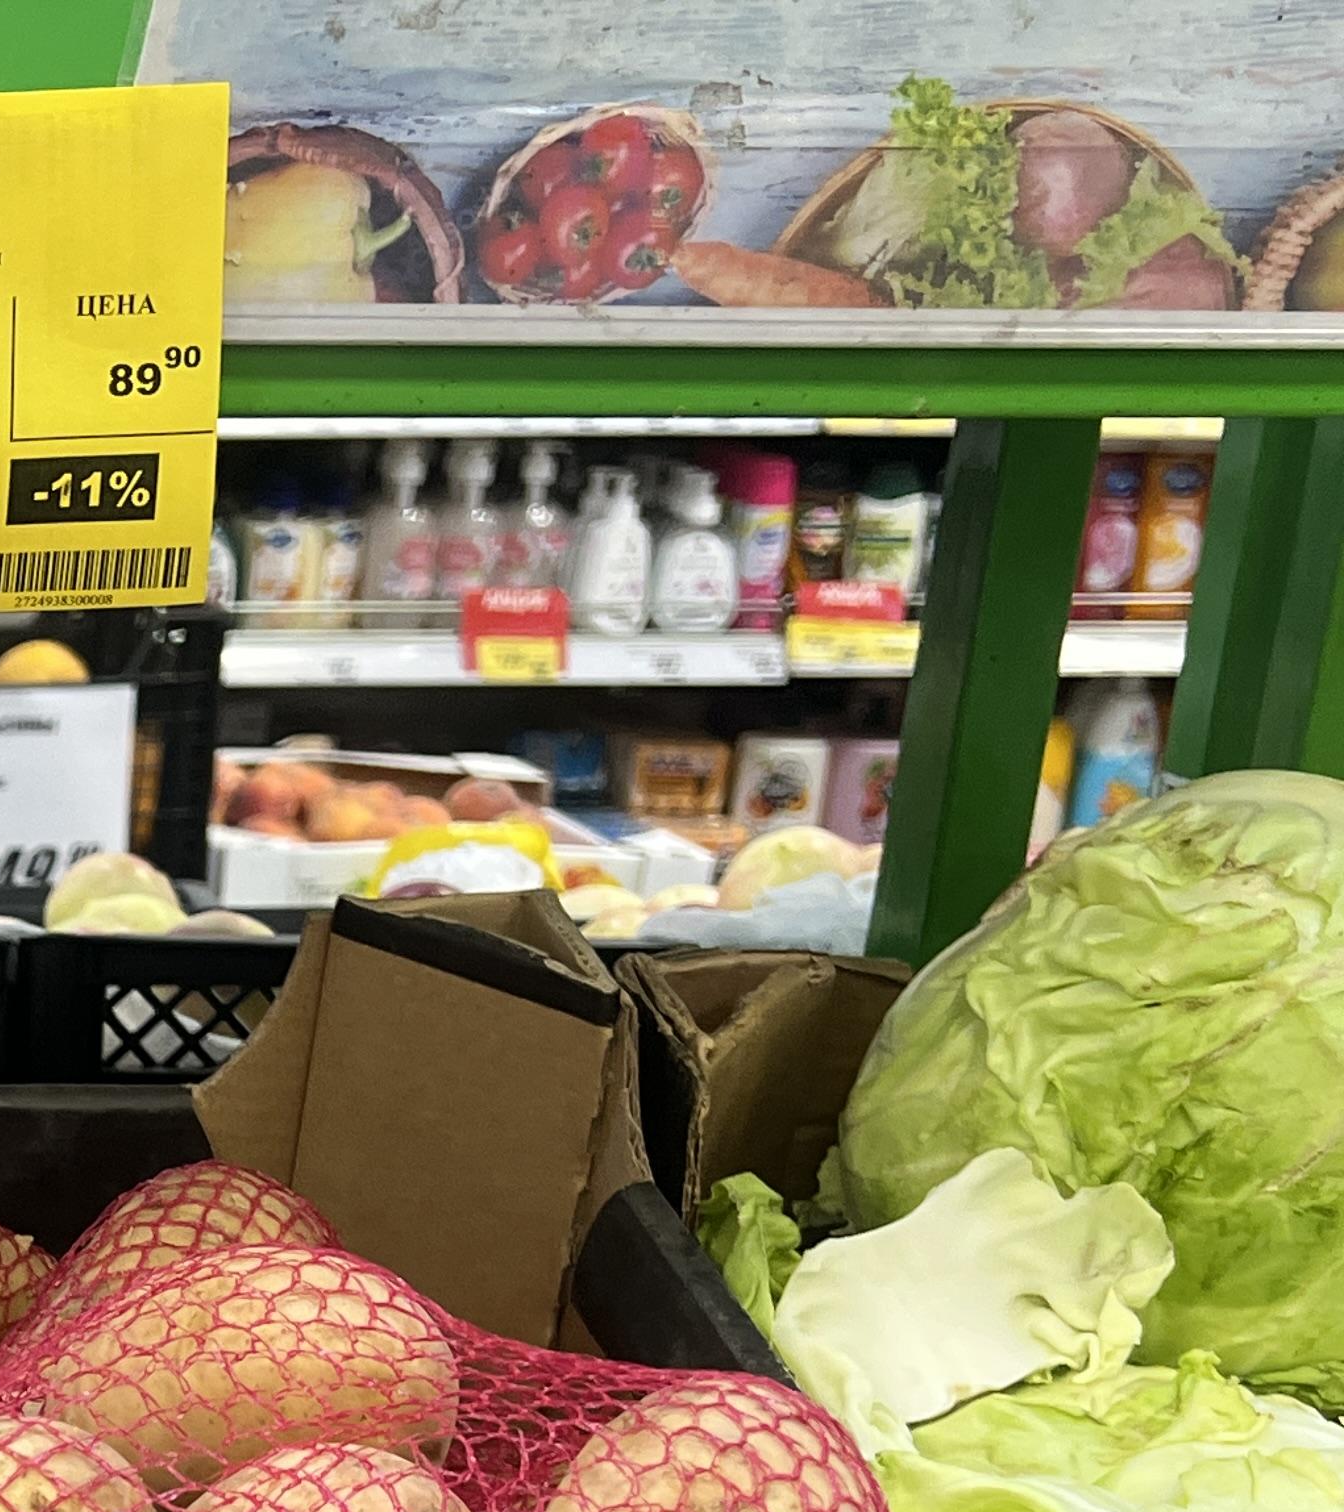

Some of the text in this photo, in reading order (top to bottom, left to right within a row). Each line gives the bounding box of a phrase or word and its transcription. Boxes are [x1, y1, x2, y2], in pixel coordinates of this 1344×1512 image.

[76, 294, 157, 320] ЦЕНА
[108, 345, 201, 397] 89 90
[32, 468, 150, 508] -11%
[13, 593, 114, 608] 2724938300008
